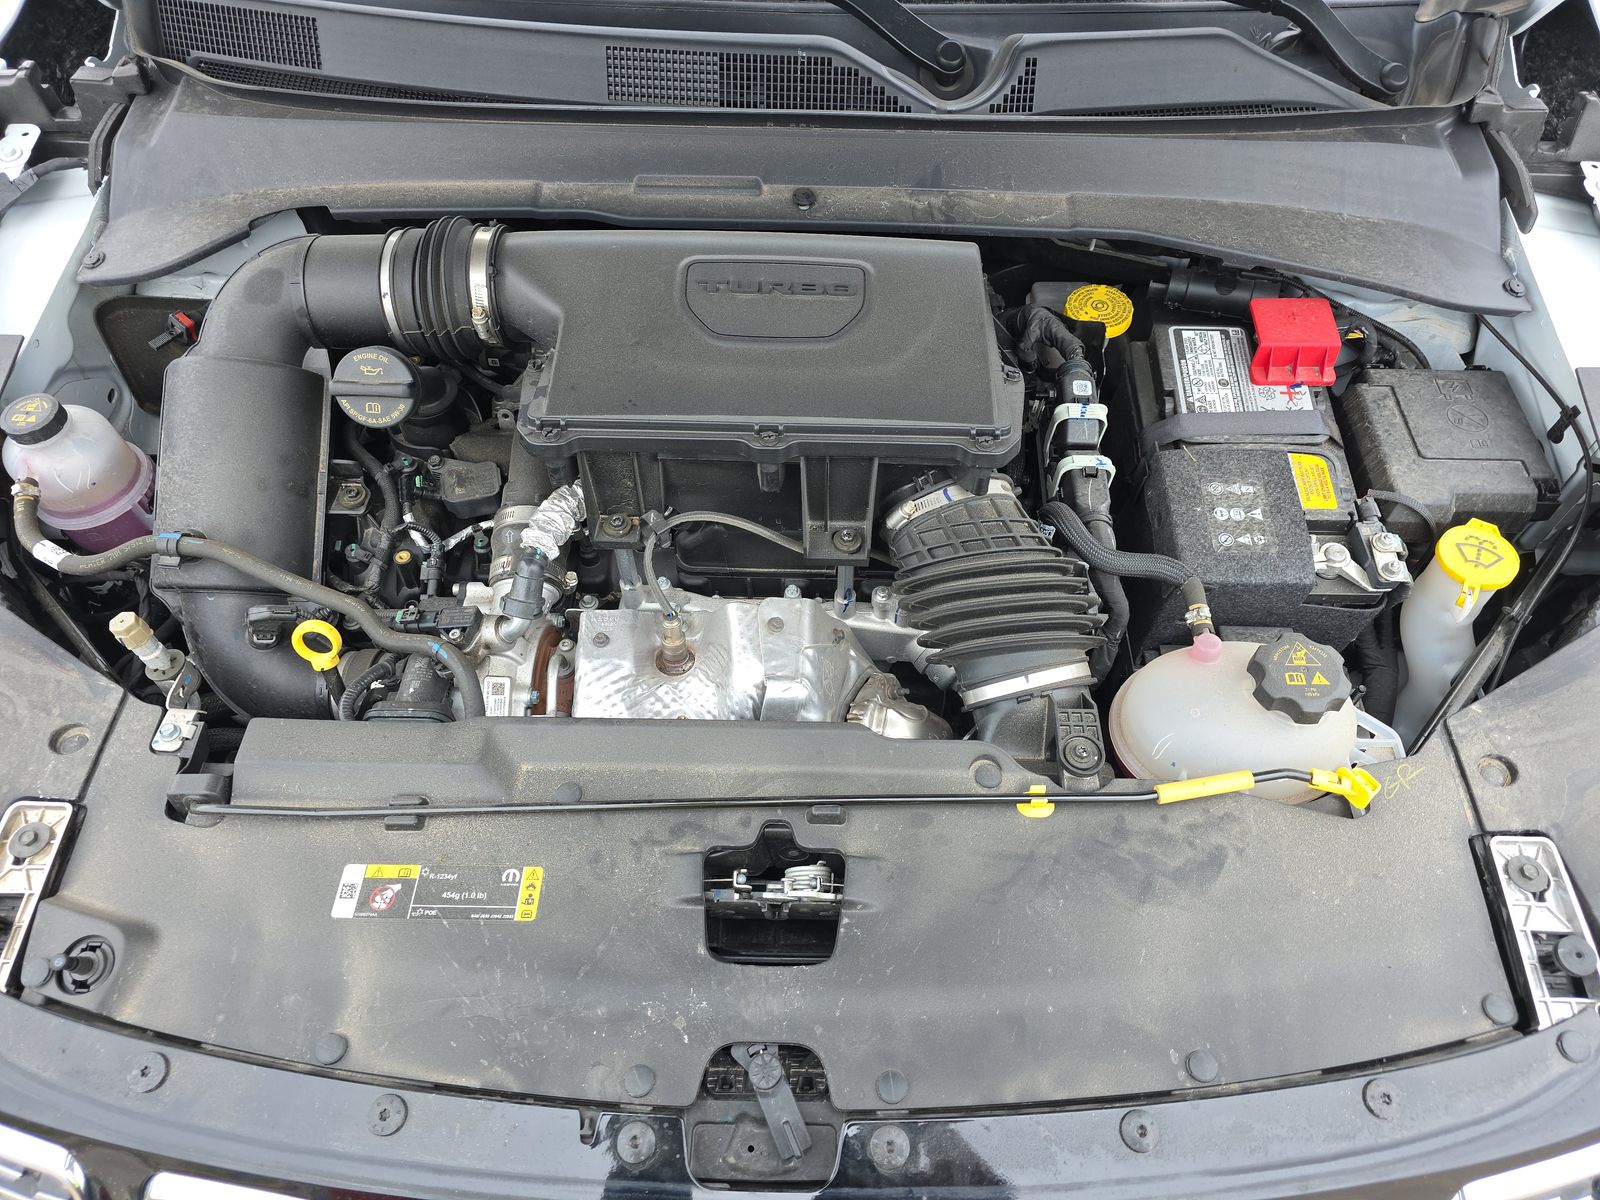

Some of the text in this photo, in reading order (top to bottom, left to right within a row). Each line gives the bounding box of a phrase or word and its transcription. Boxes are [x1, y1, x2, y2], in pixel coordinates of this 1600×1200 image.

[698, 280, 857, 297] TURBO
[353, 352, 390, 364] ENGINE OIL
[341, 399, 351, 410] API
[390, 403, 406, 419] 5W-30
[442, 891, 488, 901] 454g (1.0 lb)
